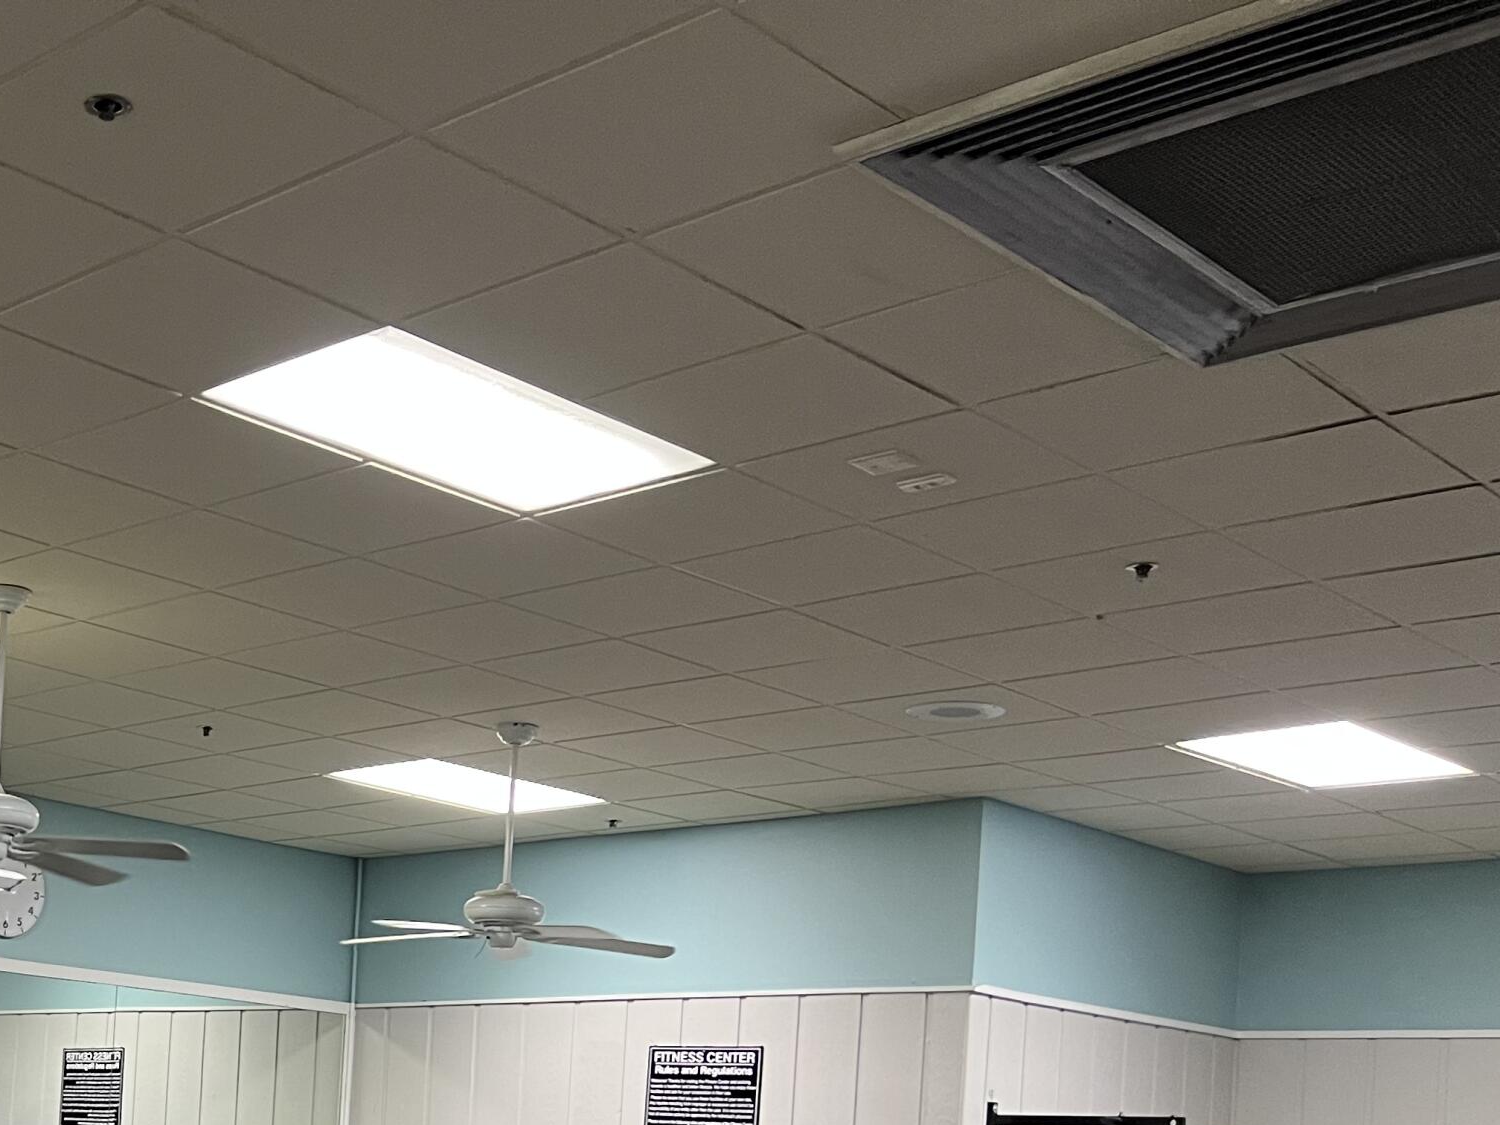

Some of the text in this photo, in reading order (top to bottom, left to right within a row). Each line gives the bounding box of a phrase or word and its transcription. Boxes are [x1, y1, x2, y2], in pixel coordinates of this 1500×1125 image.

[31, 872, 38, 882] 2
[34, 892, 40, 900] 3
[28, 906, 34, 916] 4
[2, 920, 8, 928] 6
[16, 917, 22, 926] 5
[654, 1050, 756, 1064] FITNESS CENTER
[654, 1064, 753, 1077] Rules and Regulations
